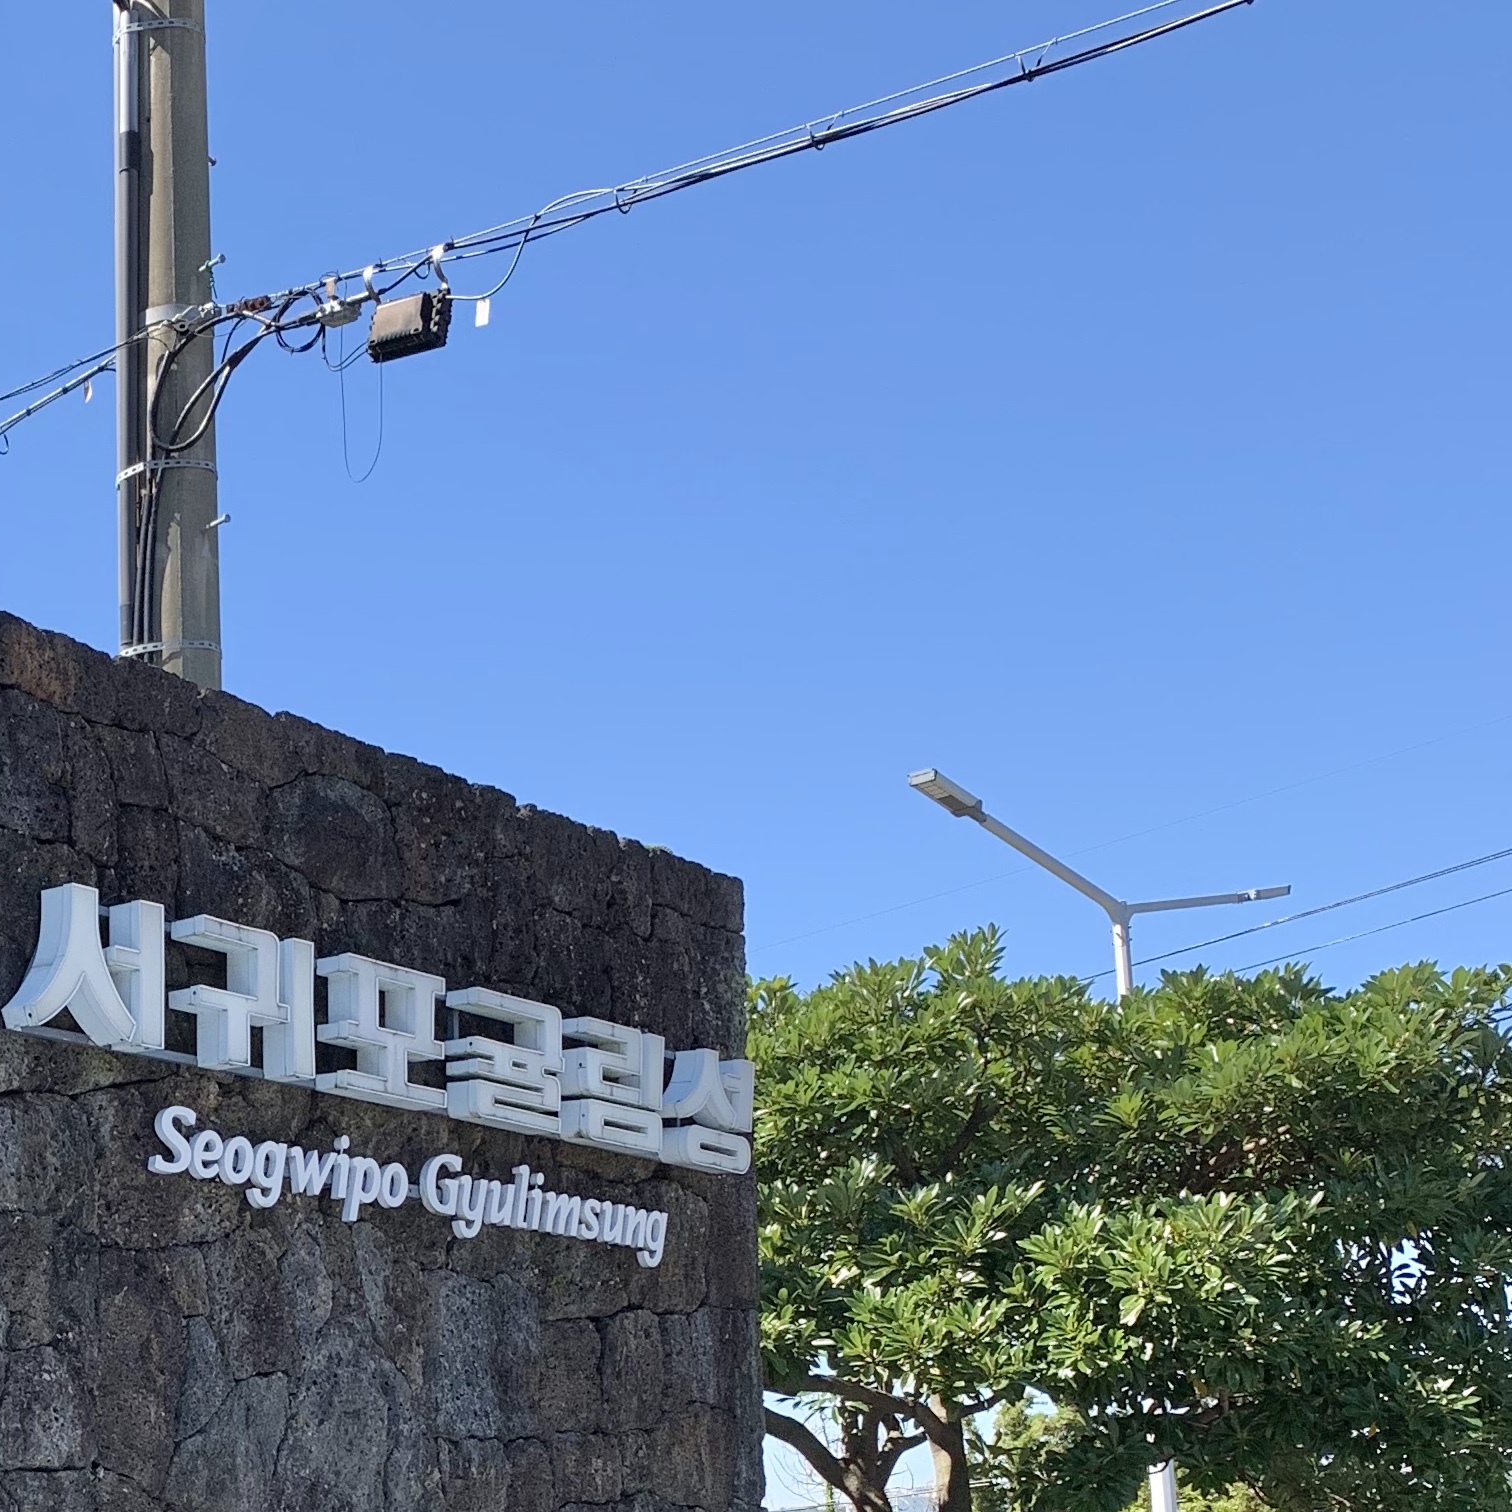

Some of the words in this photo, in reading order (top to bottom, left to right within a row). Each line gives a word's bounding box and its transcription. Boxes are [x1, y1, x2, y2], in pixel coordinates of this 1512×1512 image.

[1, 882, 754, 1174] 서귀포귤림성
[147, 1104, 410, 1222] Seogwipo
[418, 1153, 668, 1268] Gyulimsung
